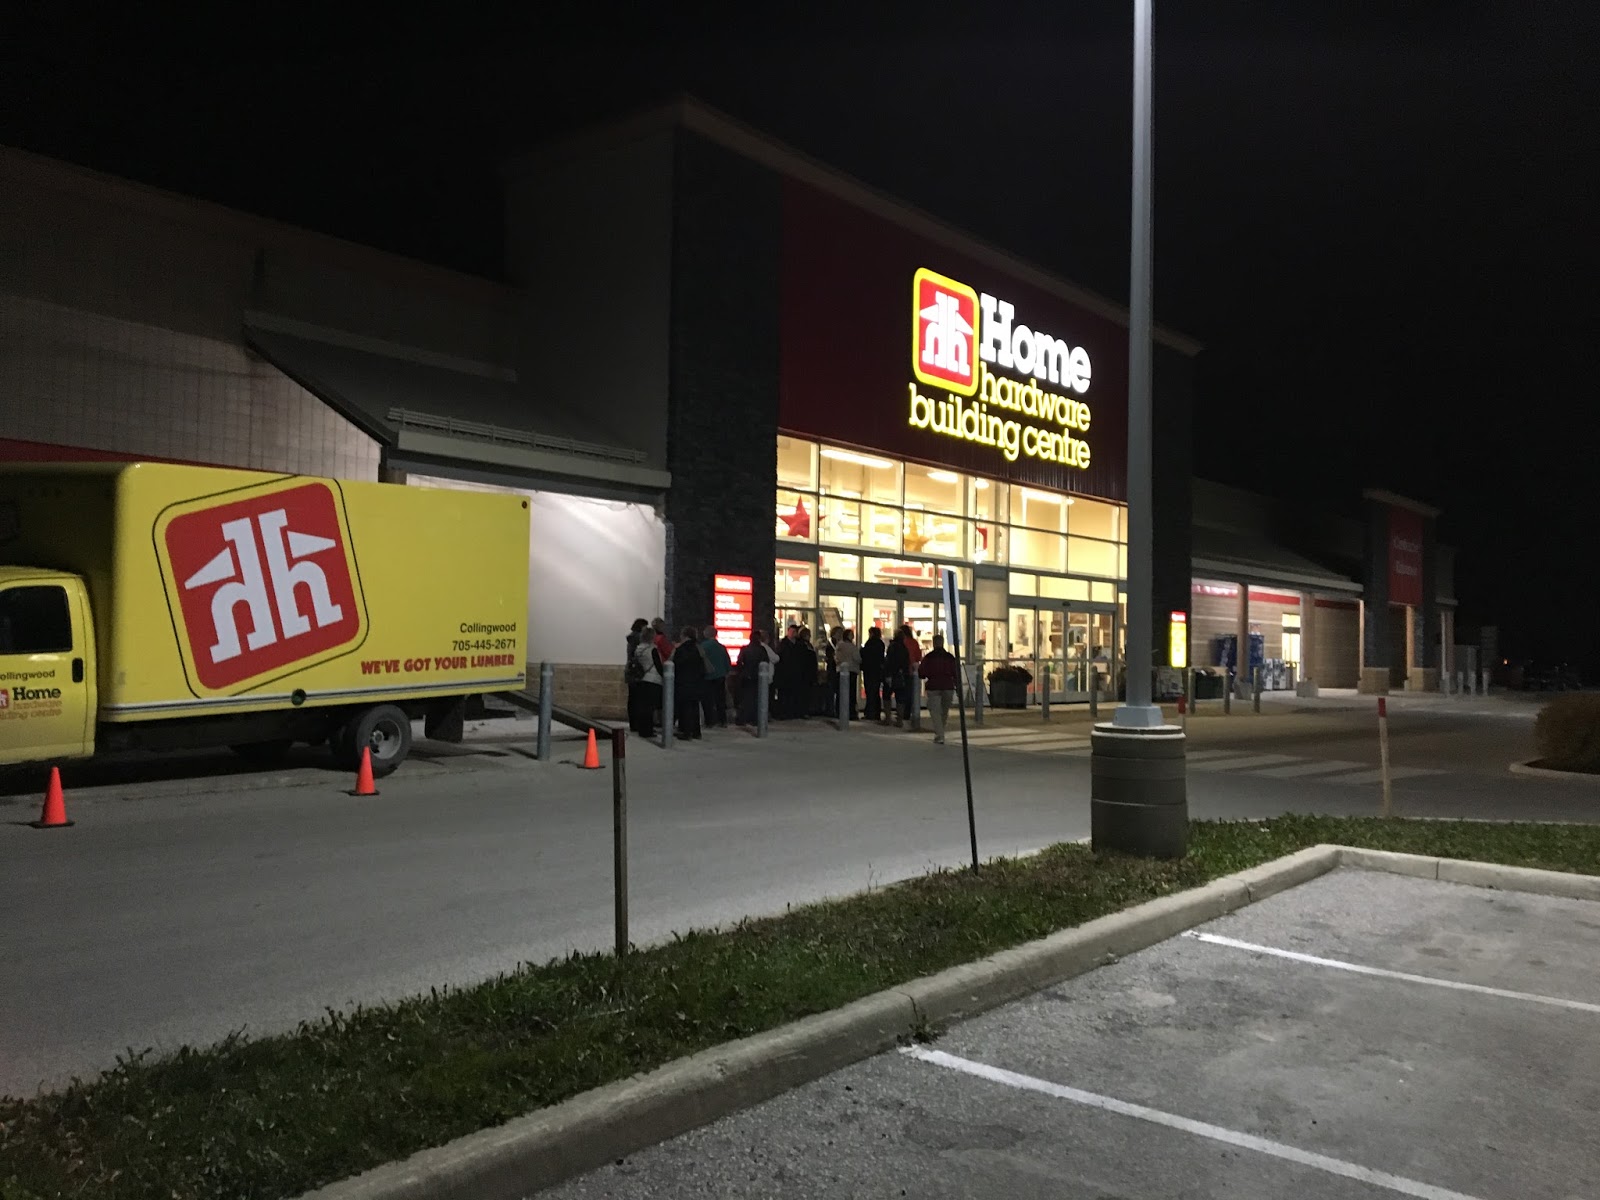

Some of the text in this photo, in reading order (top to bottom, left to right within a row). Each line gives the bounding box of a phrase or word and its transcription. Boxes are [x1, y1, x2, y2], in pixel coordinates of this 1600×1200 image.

[979, 292, 1092, 393] Home
[979, 361, 1092, 432] hardware
[908, 382, 1092, 469] building centre
[460, 622, 517, 635] Collingwood
[452, 639, 517, 651] 705-445-2671
[361, 654, 515, 675] WE'VE GOT YOUR LUMBER
[0, 670, 55, 680] ollingwood
[12, 687, 61, 700] Home
